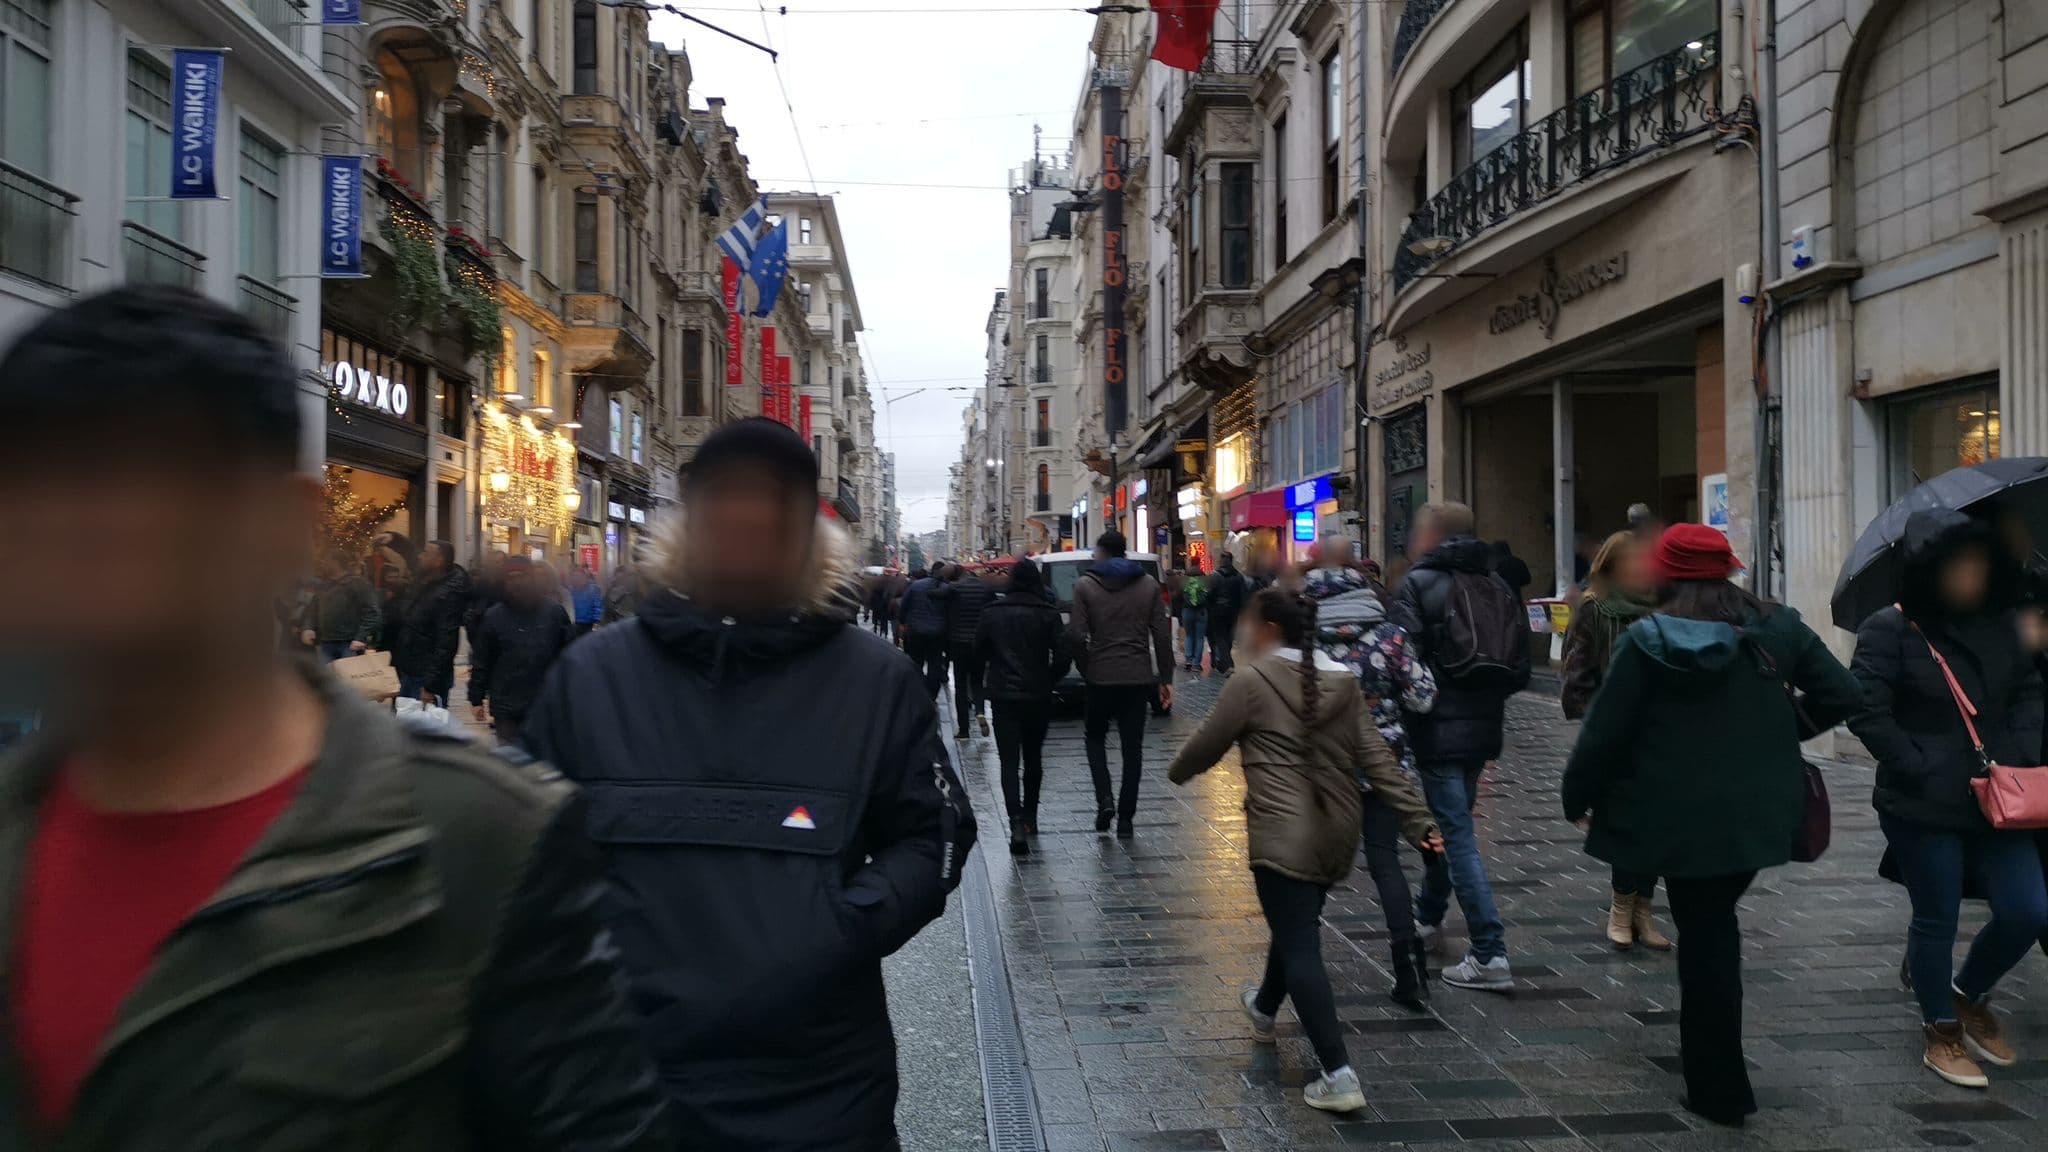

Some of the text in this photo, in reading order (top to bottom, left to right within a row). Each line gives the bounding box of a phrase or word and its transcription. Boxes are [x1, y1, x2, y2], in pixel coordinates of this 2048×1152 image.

[183, 155, 203, 185] LC
[1103, 134, 1121, 190] FLO
[331, 242, 349, 266] LC
[1104, 231, 1123, 286] FLO
[1105, 329, 1124, 384] FLO
[335, 361, 408, 415] OXXO
